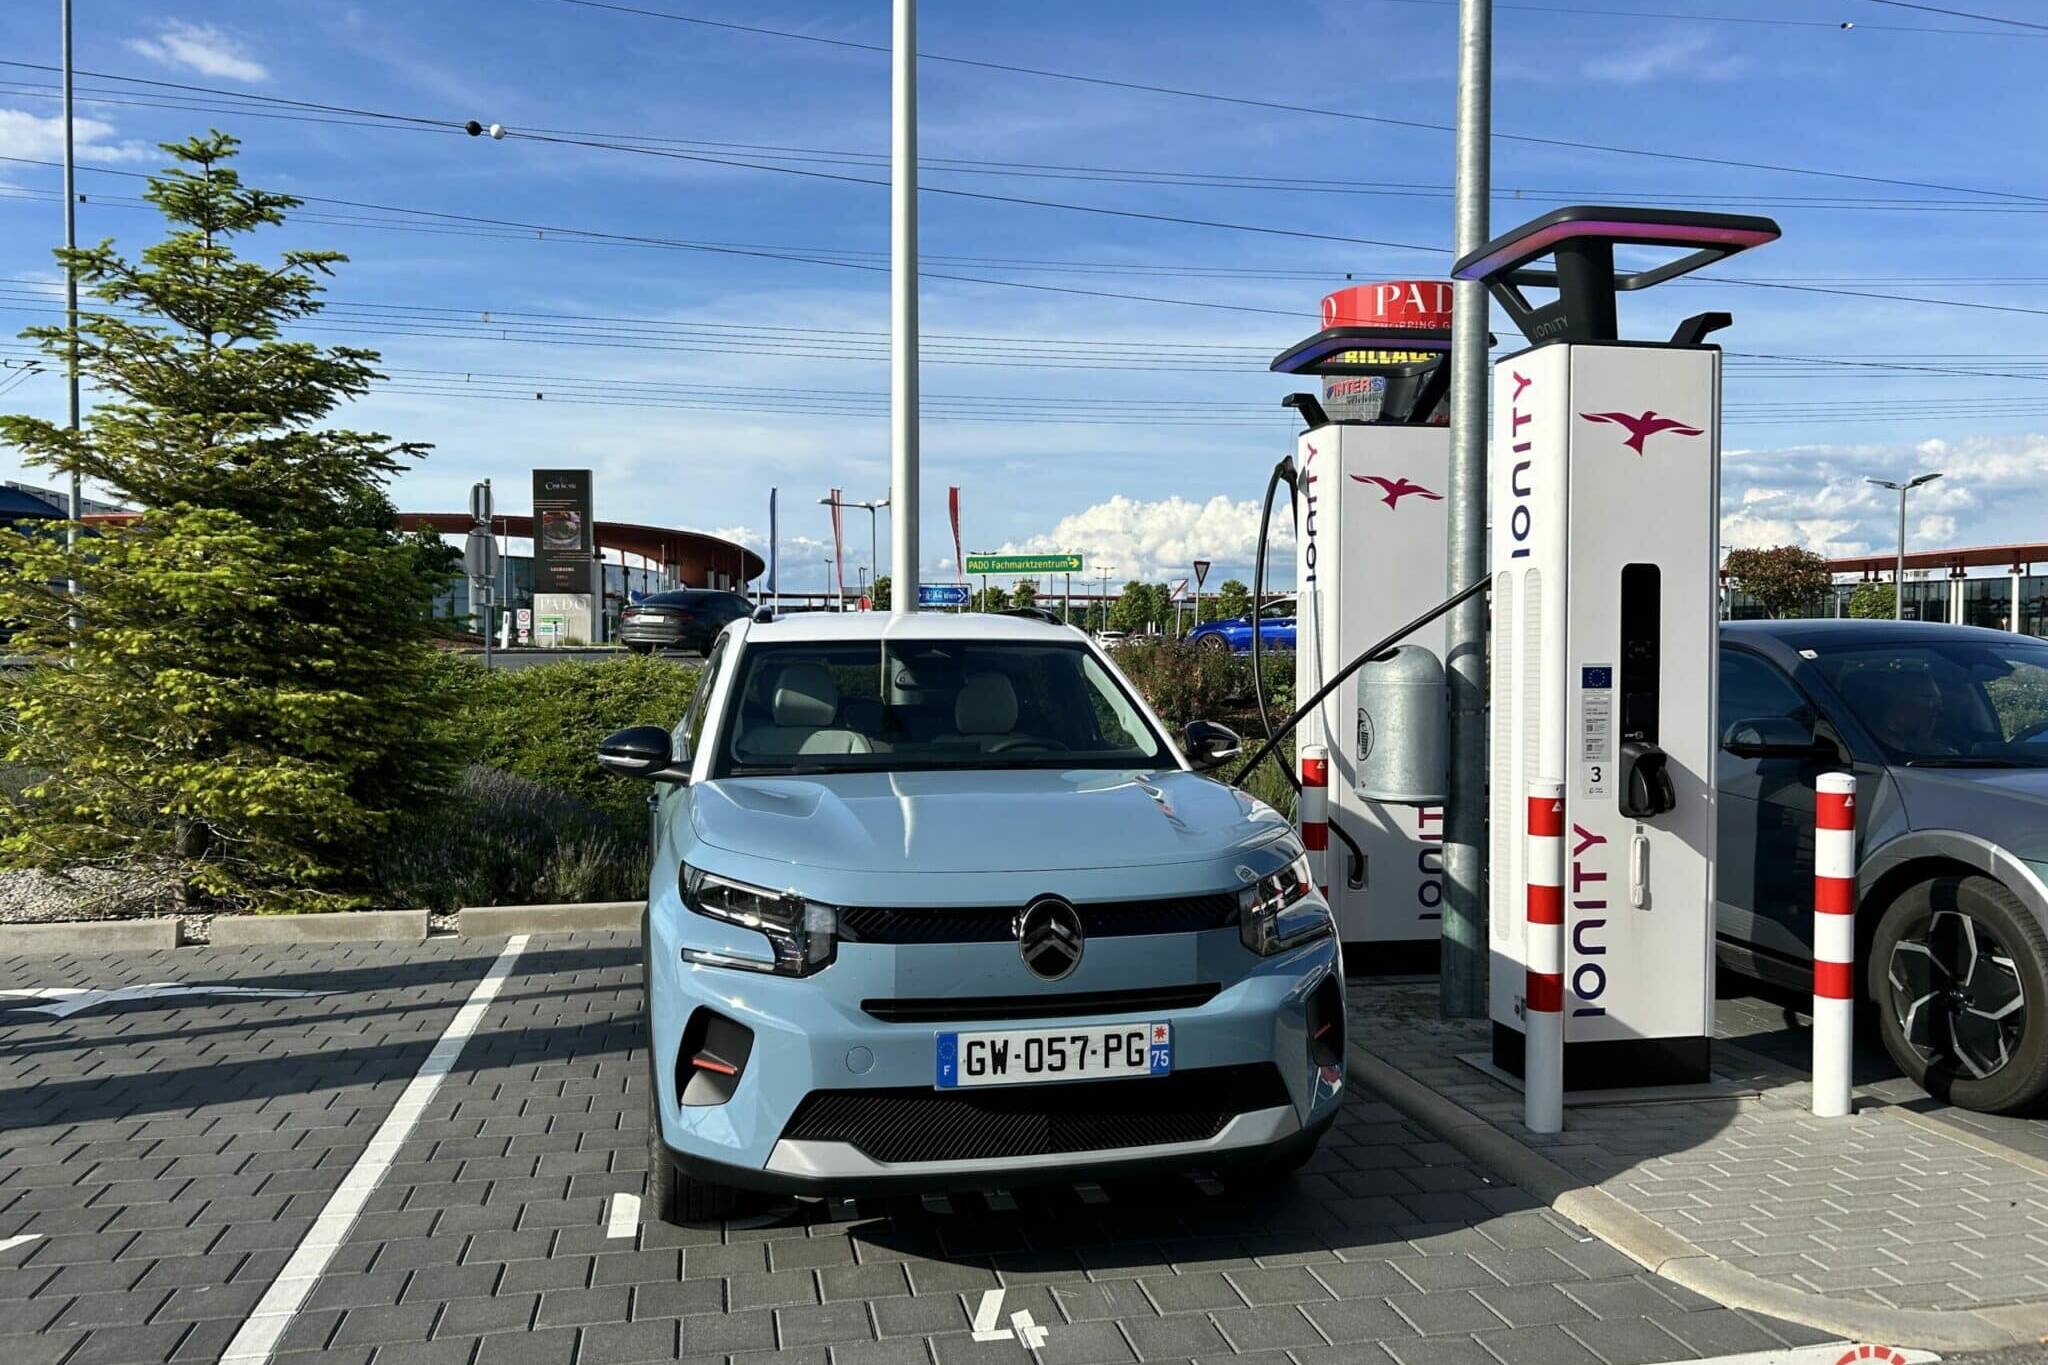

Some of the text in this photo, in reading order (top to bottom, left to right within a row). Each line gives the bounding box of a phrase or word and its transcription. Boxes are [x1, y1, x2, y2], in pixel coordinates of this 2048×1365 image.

[1375, 283, 1453, 316] PAD
[1532, 314, 1569, 339] IONITY
[1332, 376, 1385, 397] INTERS
[1511, 370, 1532, 559] IONITY
[1306, 443, 1318, 582] IONITY
[968, 559, 1068, 570] PADO Fachmarktzentrum
[540, 598, 587, 611] PADO
[1590, 766, 1602, 783] 3
[1418, 806, 1443, 920] IONIT
[1572, 823, 1608, 1018] IONITY
[966, 1031, 1145, 1076] GW-057-PG
[1151, 1049, 1169, 1068] 75
[943, 1065, 950, 1076] F
